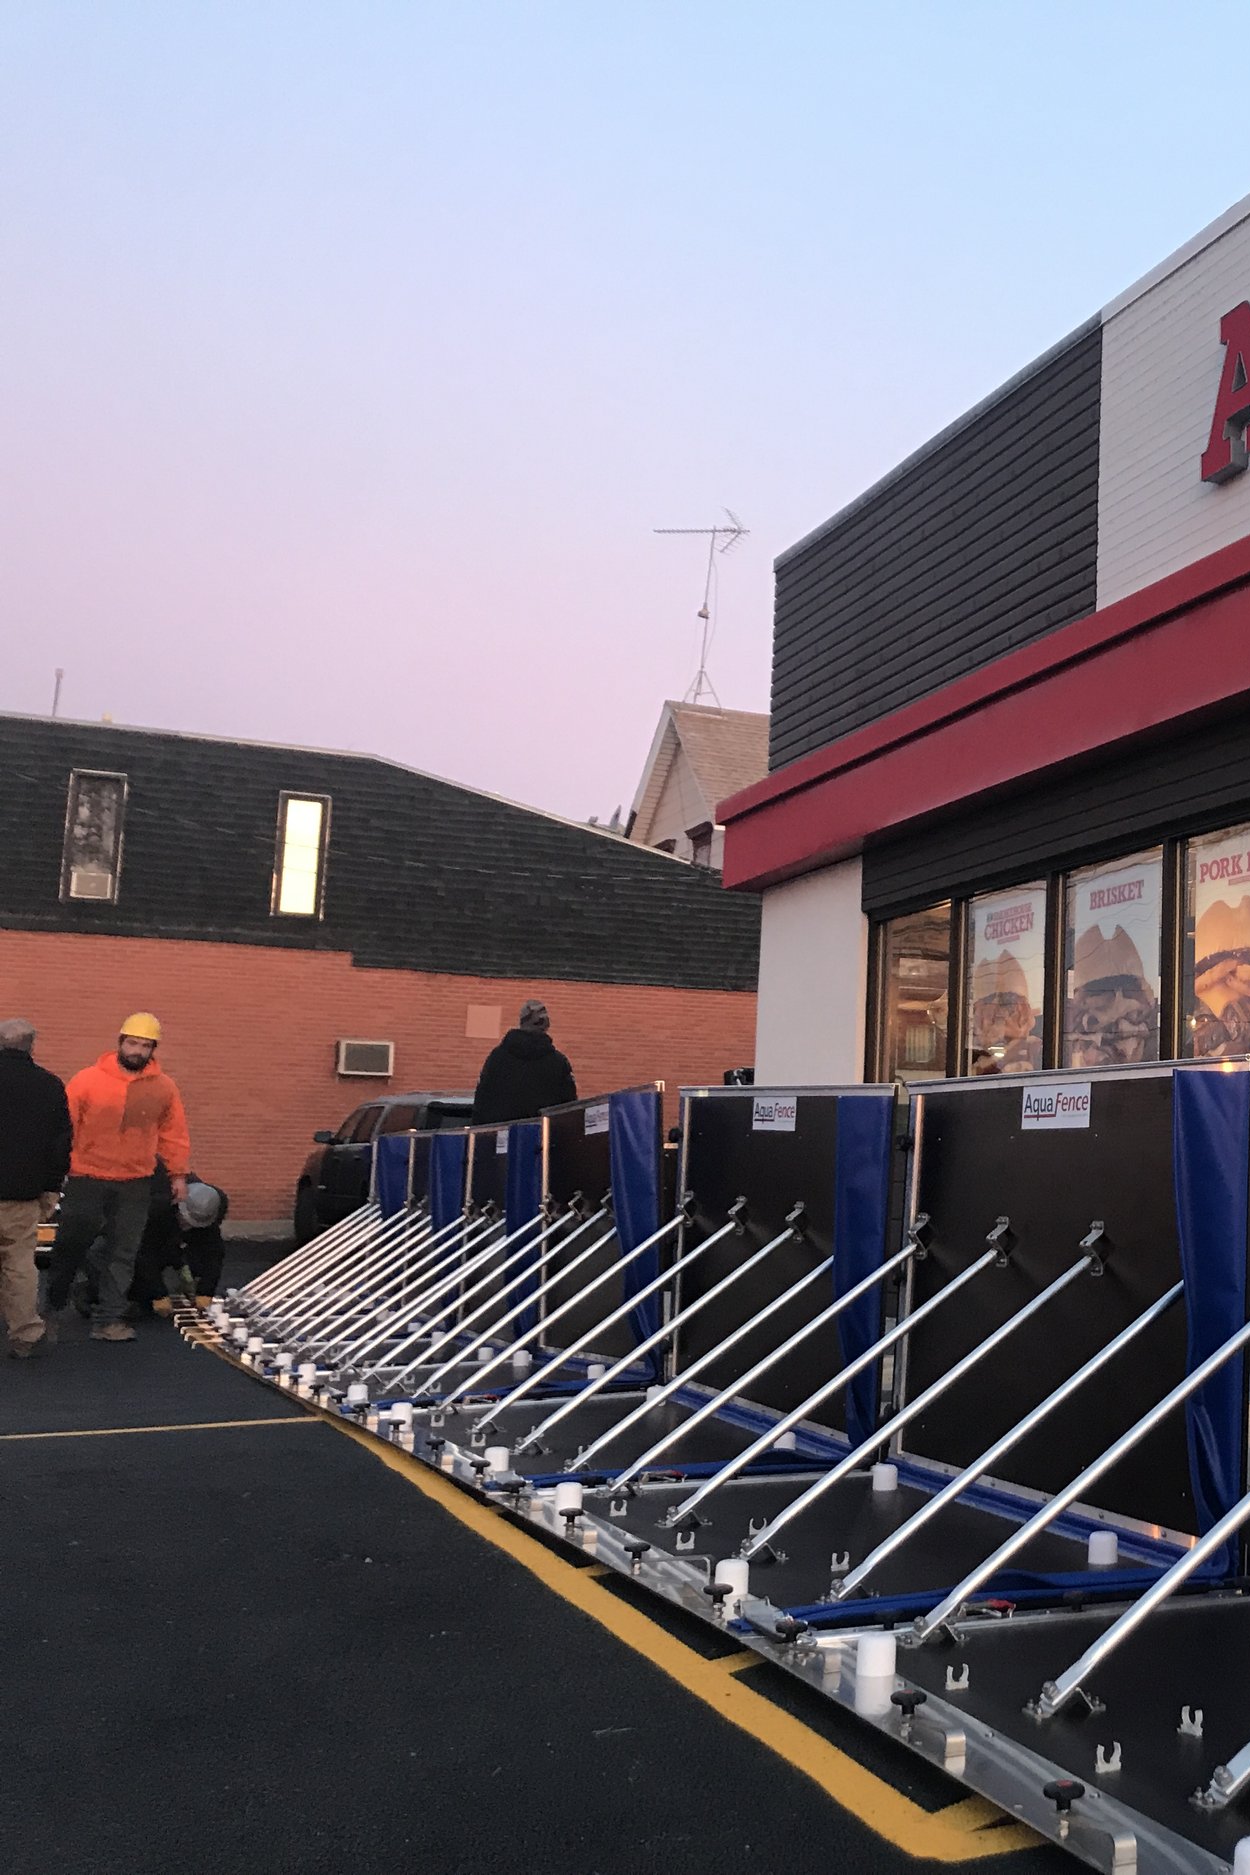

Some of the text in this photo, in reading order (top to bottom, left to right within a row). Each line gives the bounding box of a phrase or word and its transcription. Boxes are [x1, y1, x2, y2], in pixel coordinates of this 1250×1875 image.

[1200, 853, 1243, 884] PORK
[1089, 879, 1145, 910] BRISKET
[984, 911, 1035, 941] CHICKEN
